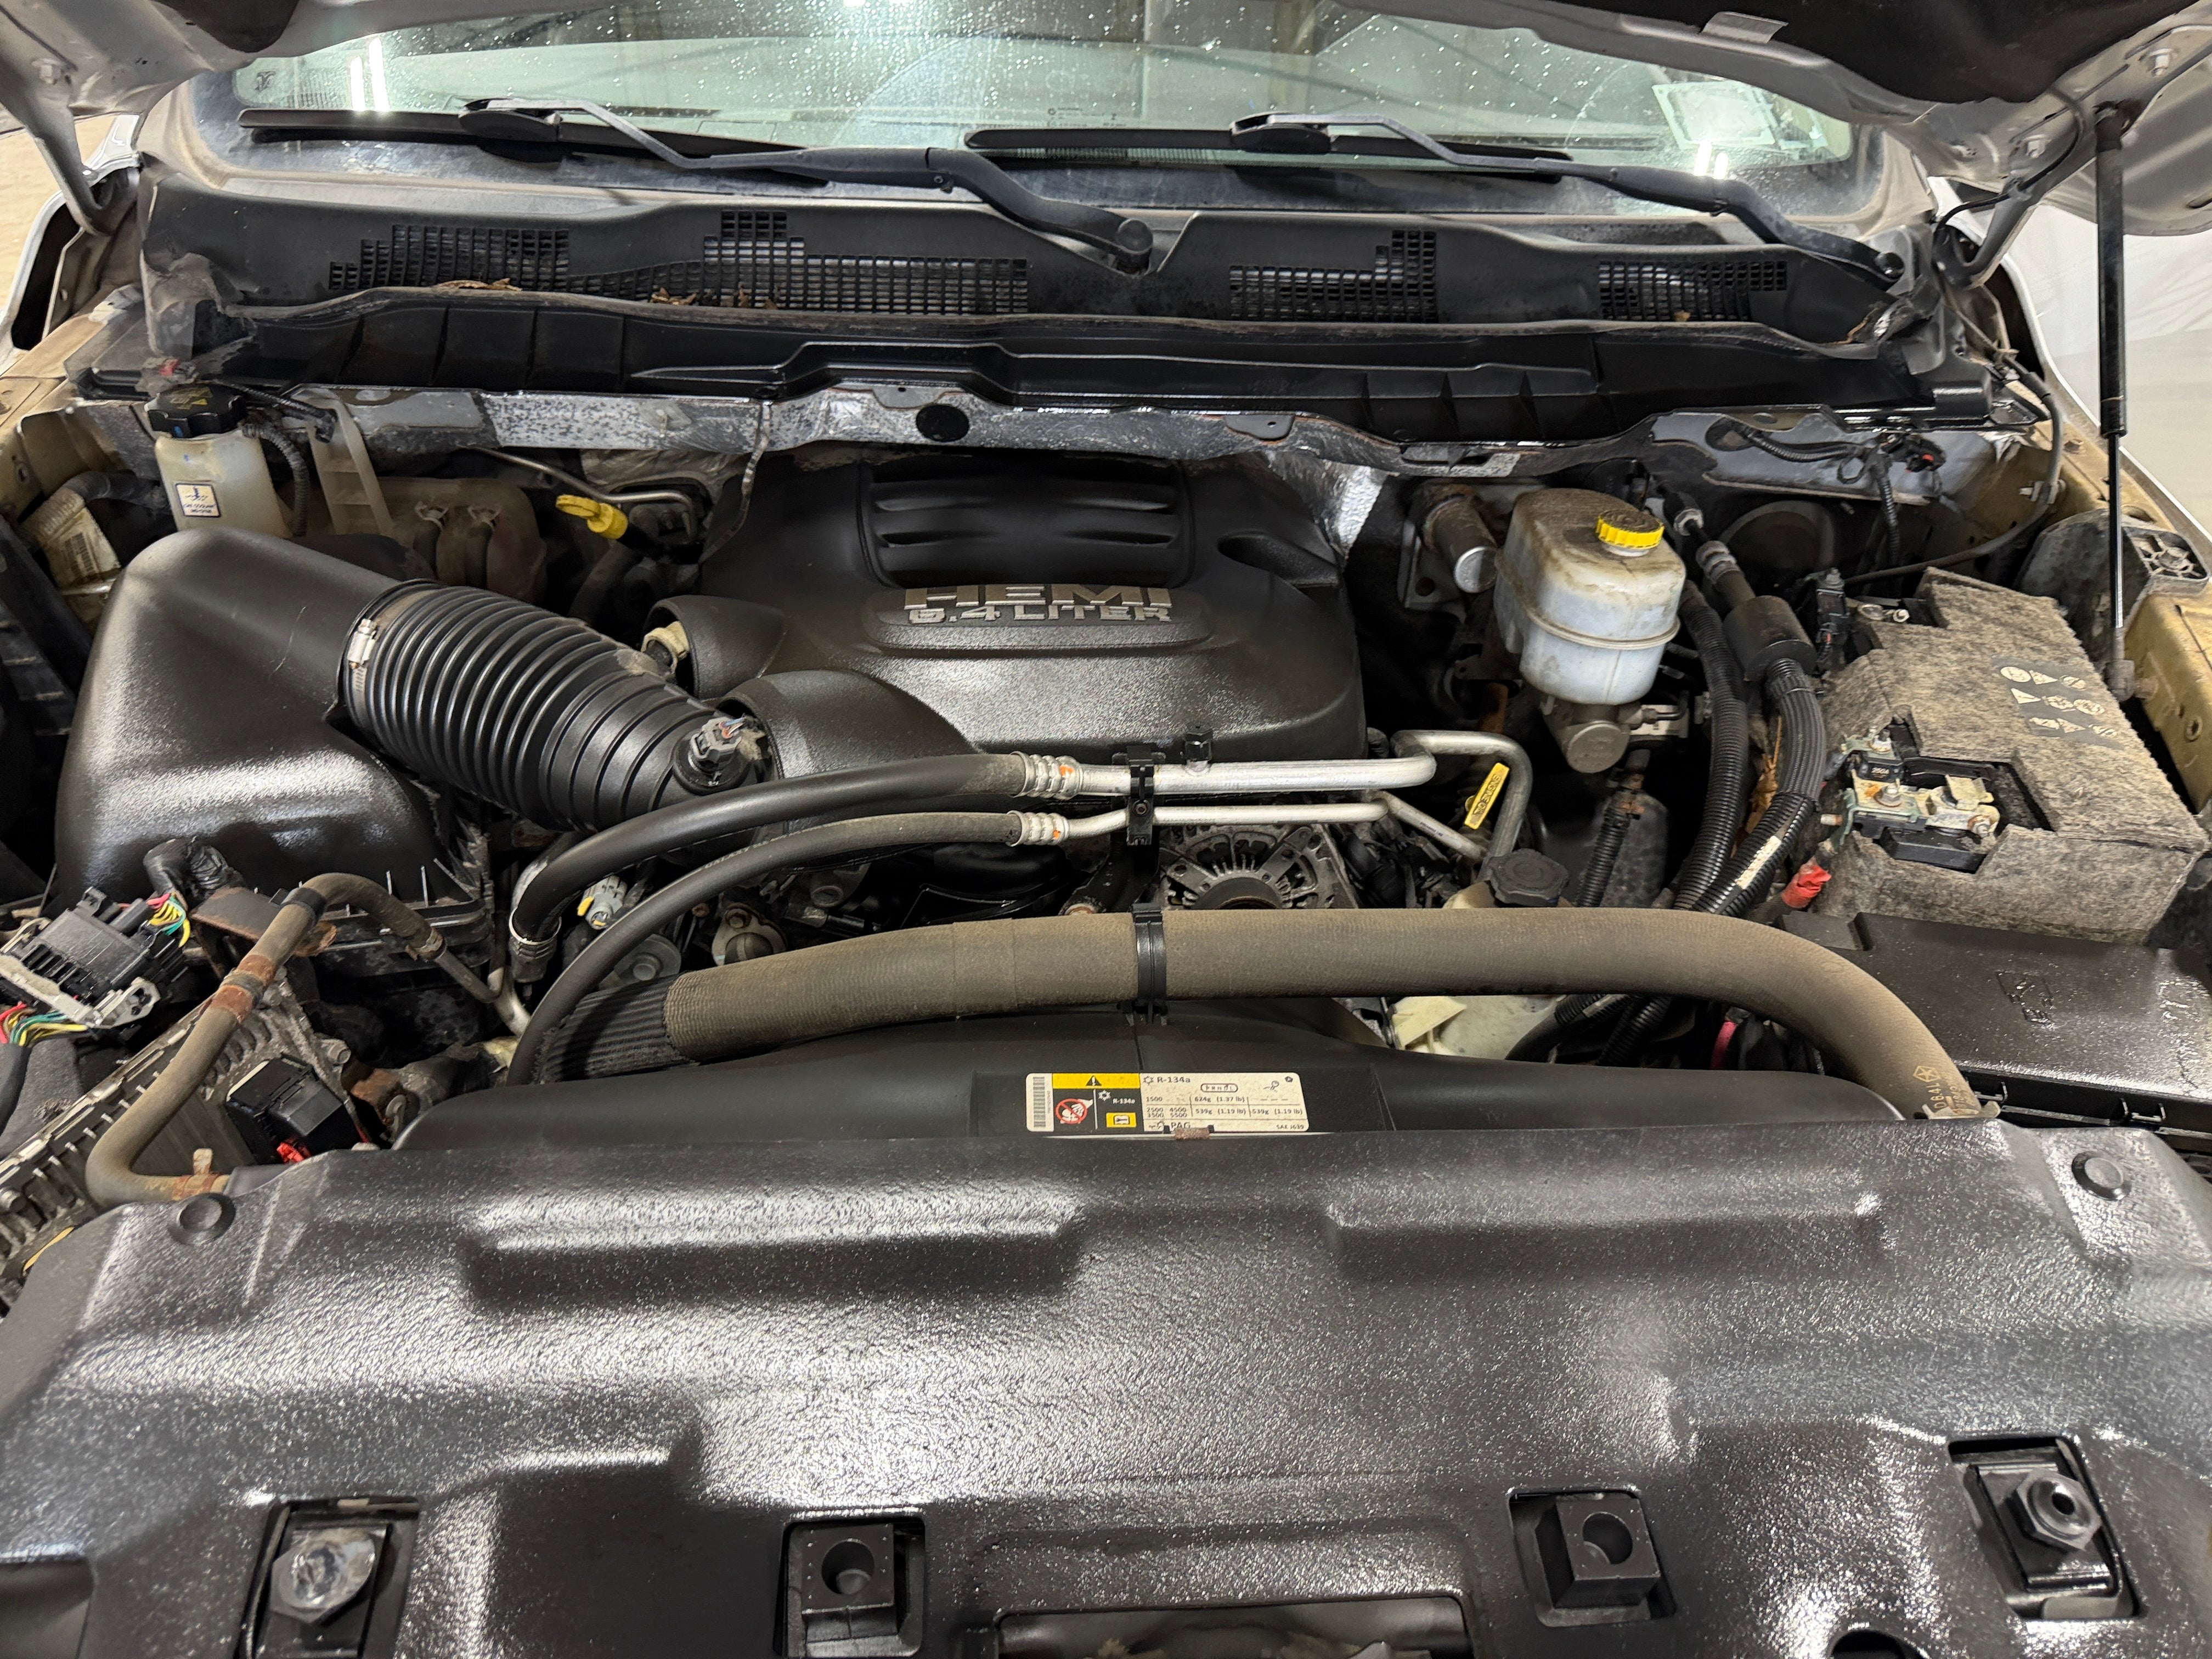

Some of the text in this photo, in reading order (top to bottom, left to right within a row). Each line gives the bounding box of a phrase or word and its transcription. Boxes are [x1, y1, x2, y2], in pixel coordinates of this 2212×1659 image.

[905, 584, 1172, 609] HEMI
[908, 605, 1172, 624] 6.4 LITER
